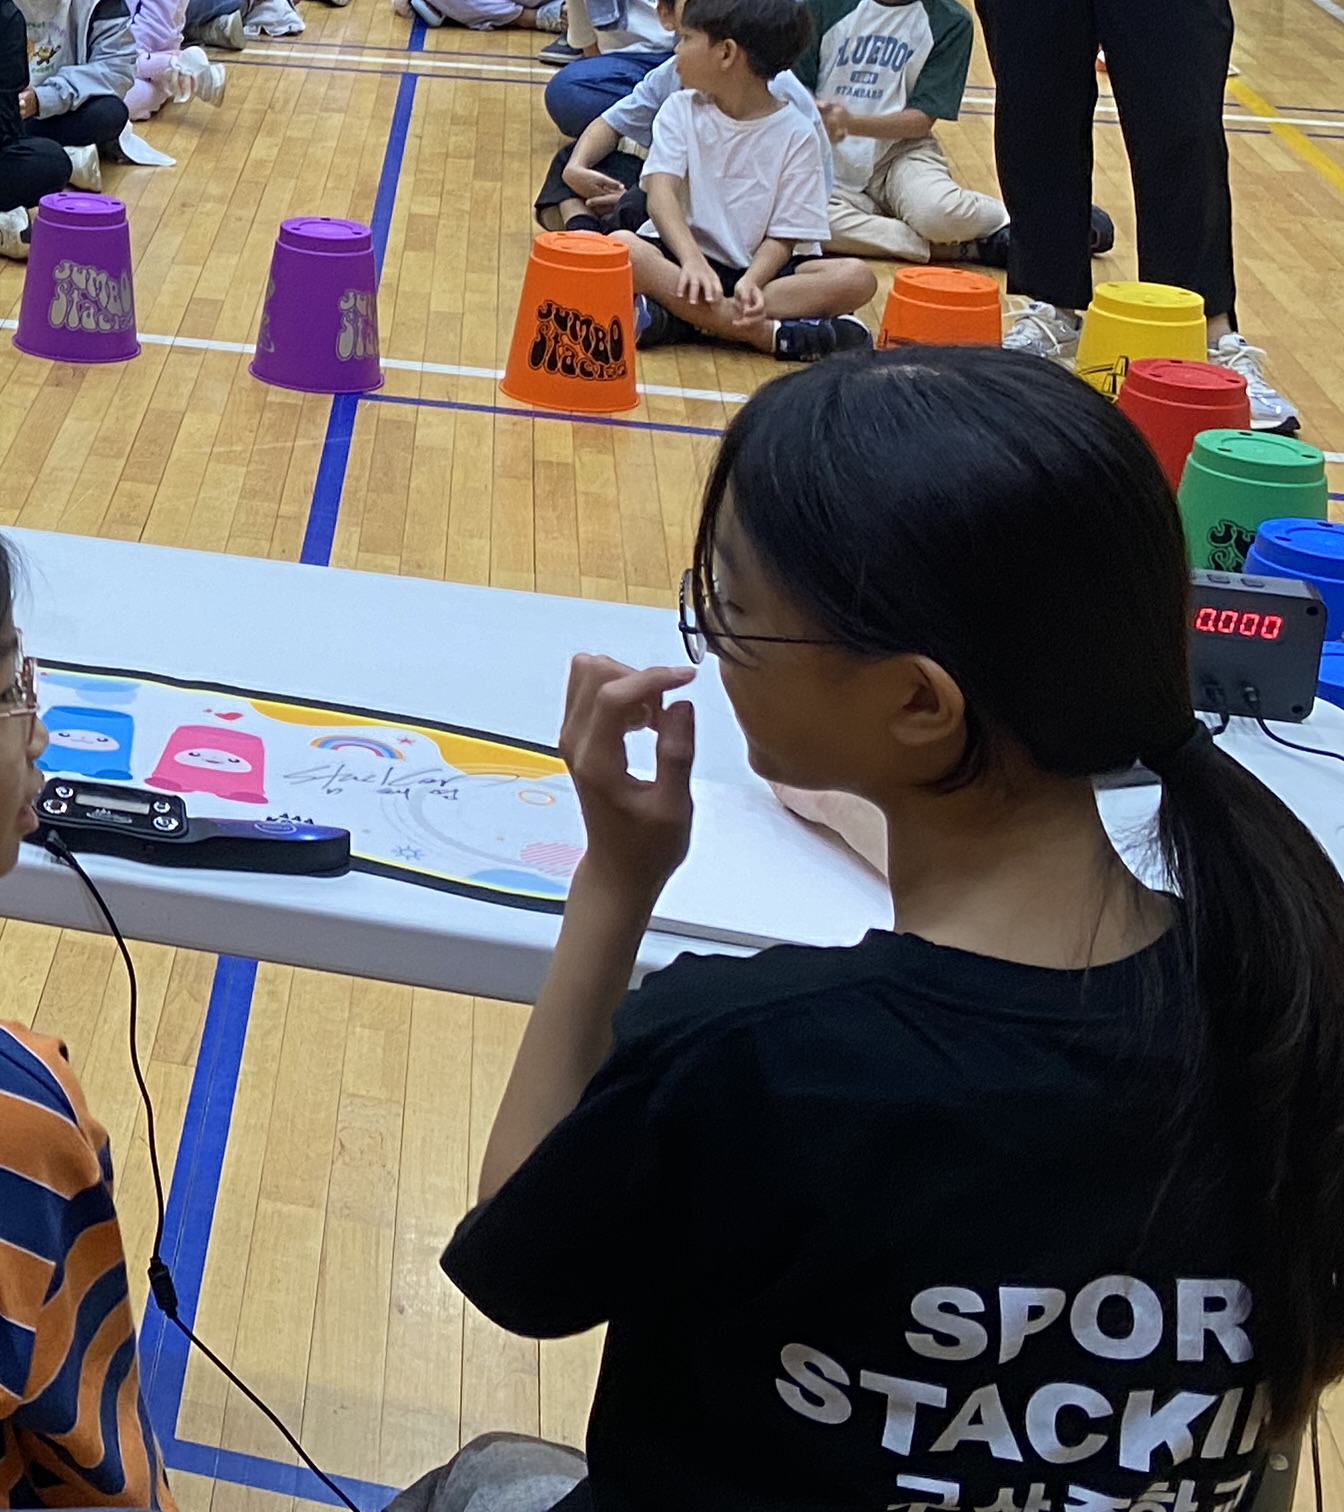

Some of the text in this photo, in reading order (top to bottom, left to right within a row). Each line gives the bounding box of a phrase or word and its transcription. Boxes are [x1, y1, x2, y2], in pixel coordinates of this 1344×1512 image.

[836, 35, 915, 73] LUEDO
[53, 259, 132, 316] JUMBO
[537, 299, 625, 364] JUMBO
[1195, 606, 1284, 640] 0.000
[904, 1274, 1255, 1364] SPOR
[774, 1343, 1271, 1473] STACKI
